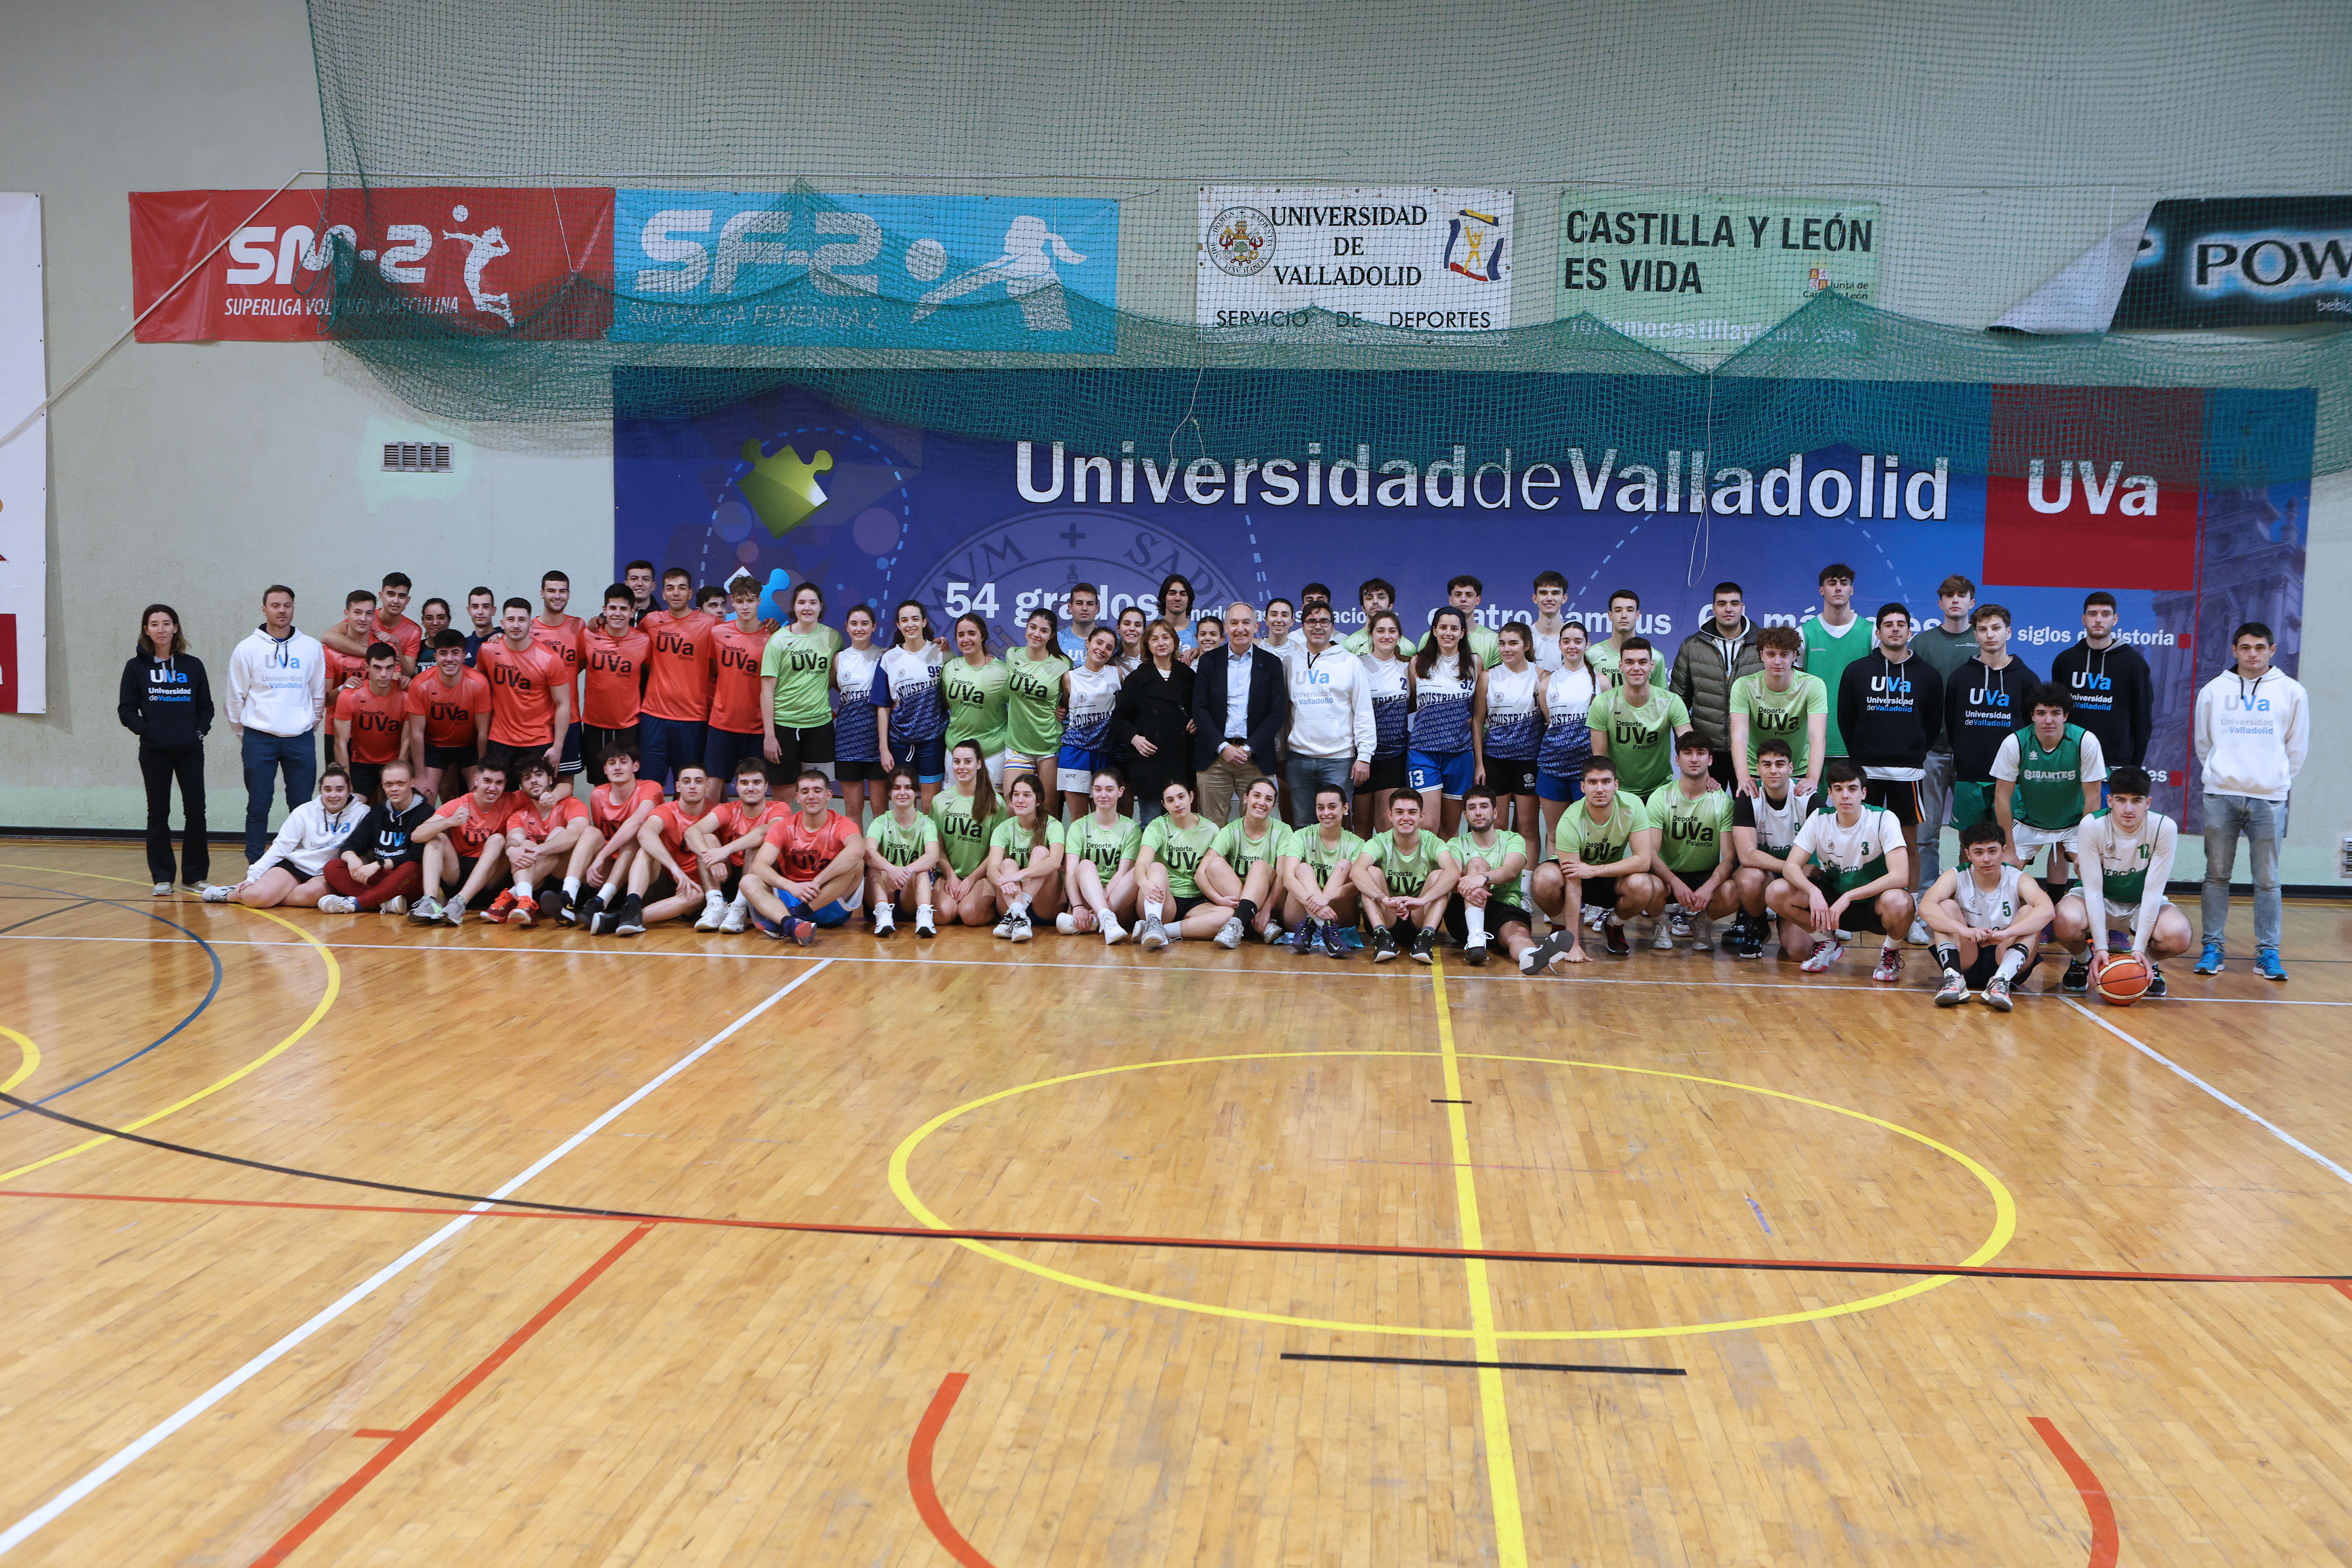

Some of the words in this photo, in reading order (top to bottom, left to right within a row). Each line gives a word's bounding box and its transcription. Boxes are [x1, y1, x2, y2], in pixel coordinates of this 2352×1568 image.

[1272, 206, 1427, 227] UNIVERSIDAD
[1567, 210, 1735, 248] CASTILLA
[1748, 216, 1770, 249] Y
[1782, 212, 1872, 252] LEÓN
[1334, 236, 1364, 256] DE
[1274, 266, 1421, 286] VALLADOLID
[1565, 258, 1607, 290] ES
[1621, 259, 1702, 294] VIDA
[225, 298, 302, 316] SUPERLIGA
[1217, 311, 1308, 328] SERVICIO
[1337, 311, 1361, 328] DE
[1390, 312, 1490, 329] DEPORTES
[2027, 459, 2158, 516] UVa
[944, 583, 1000, 619] 54
[2018, 626, 2071, 645] siglos
[656, 635, 693, 656] UVa
[265, 654, 300, 669] UVa
[592, 653, 632, 673] UVa
[721, 649, 758, 673] UVa
[791, 653, 828, 671] UVa
[150, 670, 188, 683] UVa
[494, 667, 531, 690] UVa
[952, 677, 973, 686] Deporte
[1295, 670, 1329, 684] UVa
[1400, 677, 1407, 690] 2
[1871, 676, 1911, 693] UVa
[2072, 671, 2112, 690] UVa
[948, 682, 985, 704] UVa
[1009, 673, 1047, 699] UVa
[1293, 690, 1332, 698] Universidad
[960, 700, 983, 710] Palencia
[1866, 696, 1913, 706] Universidad
[1969, 688, 2010, 707] UVa
[2070, 693, 2113, 703] niversidad
[2225, 695, 2270, 711] UVa
[431, 705, 468, 721] UVa
[1757, 713, 1799, 731] UVa
[1965, 710, 2011, 720] Universidad
[359, 715, 400, 732] UVa
[1616, 726, 1658, 745] UVa
[1408, 769, 1425, 788] 13
[2024, 769, 2076, 781] GIGANTES
[944, 817, 982, 838] UVa
[1671, 821, 1713, 842] UVa
[1861, 841, 1869, 855] 3
[2003, 901, 2011, 917] 5
